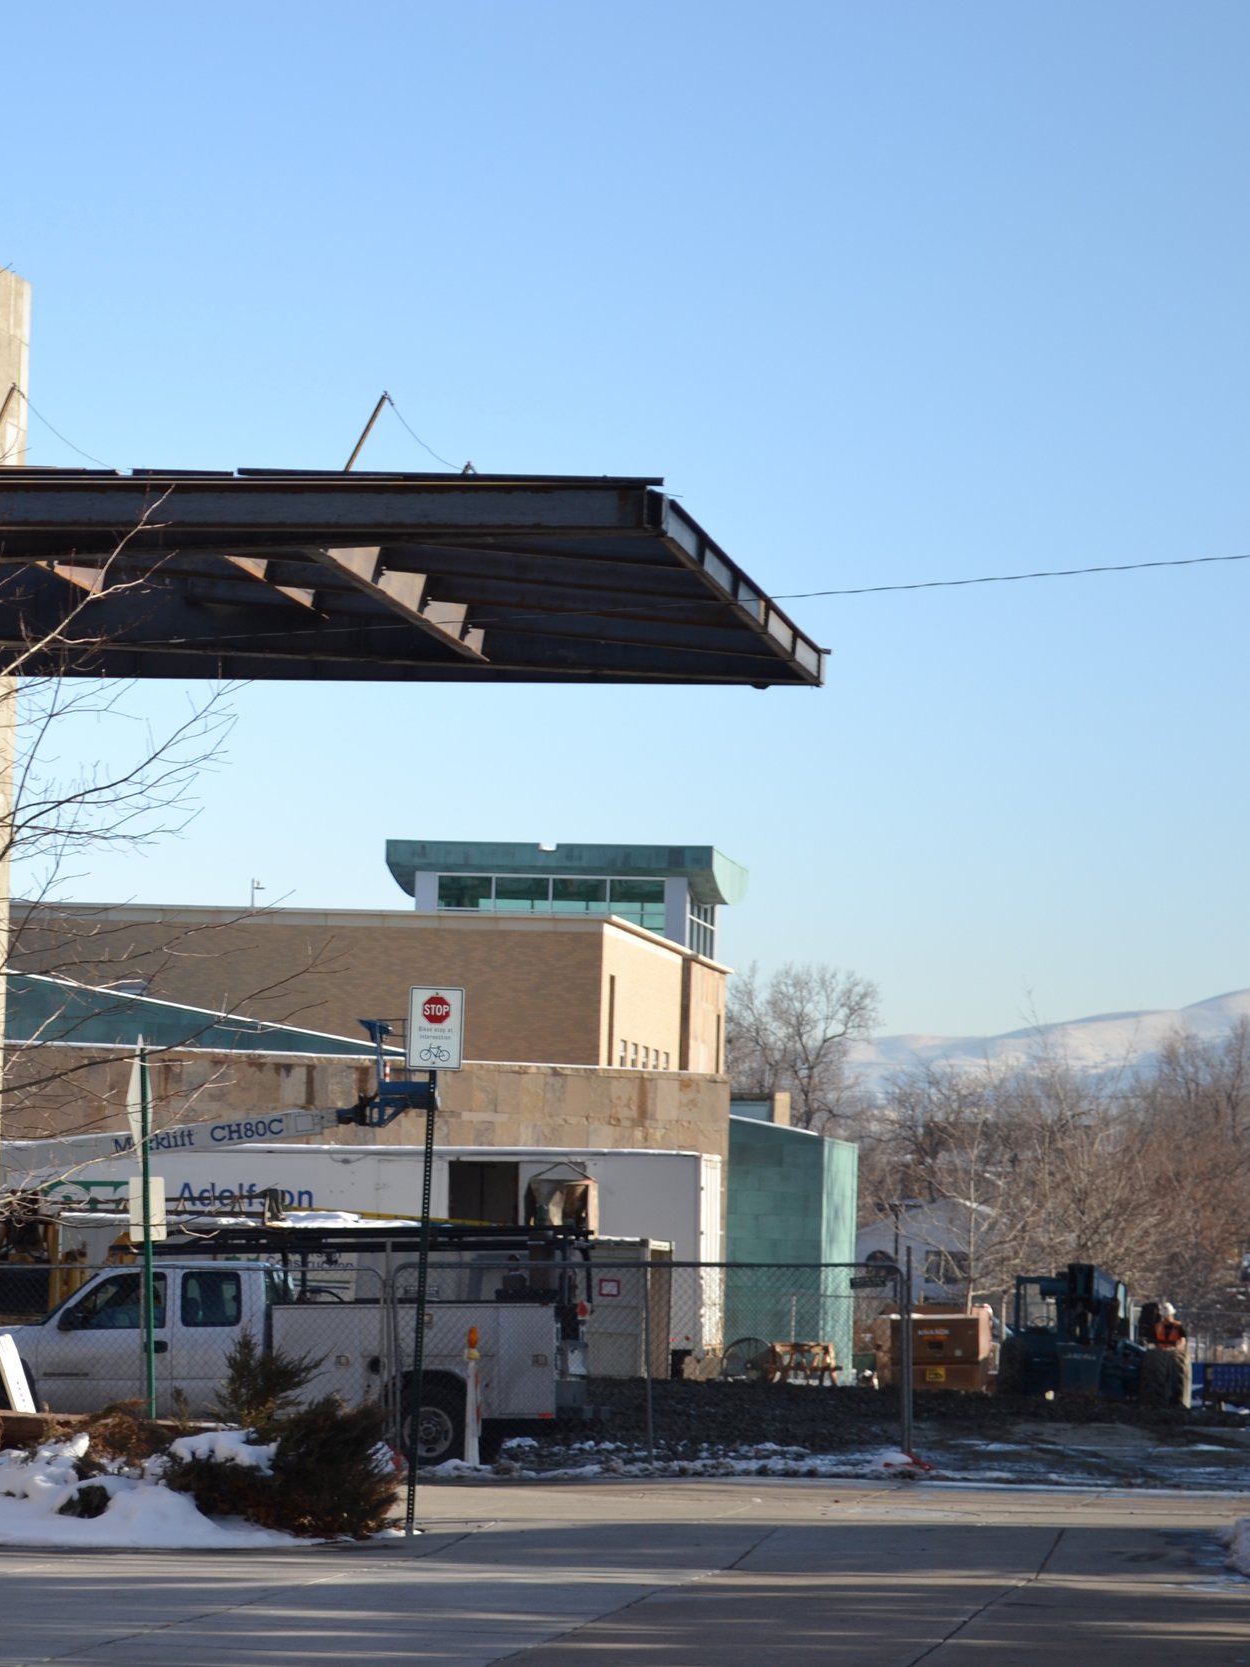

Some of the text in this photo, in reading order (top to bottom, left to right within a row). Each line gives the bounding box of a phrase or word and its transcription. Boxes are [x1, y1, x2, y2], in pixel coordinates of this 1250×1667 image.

[423, 1004, 450, 1016] STOP
[434, 1026, 446, 1034] stop
[210, 1117, 284, 1142] CH80C
